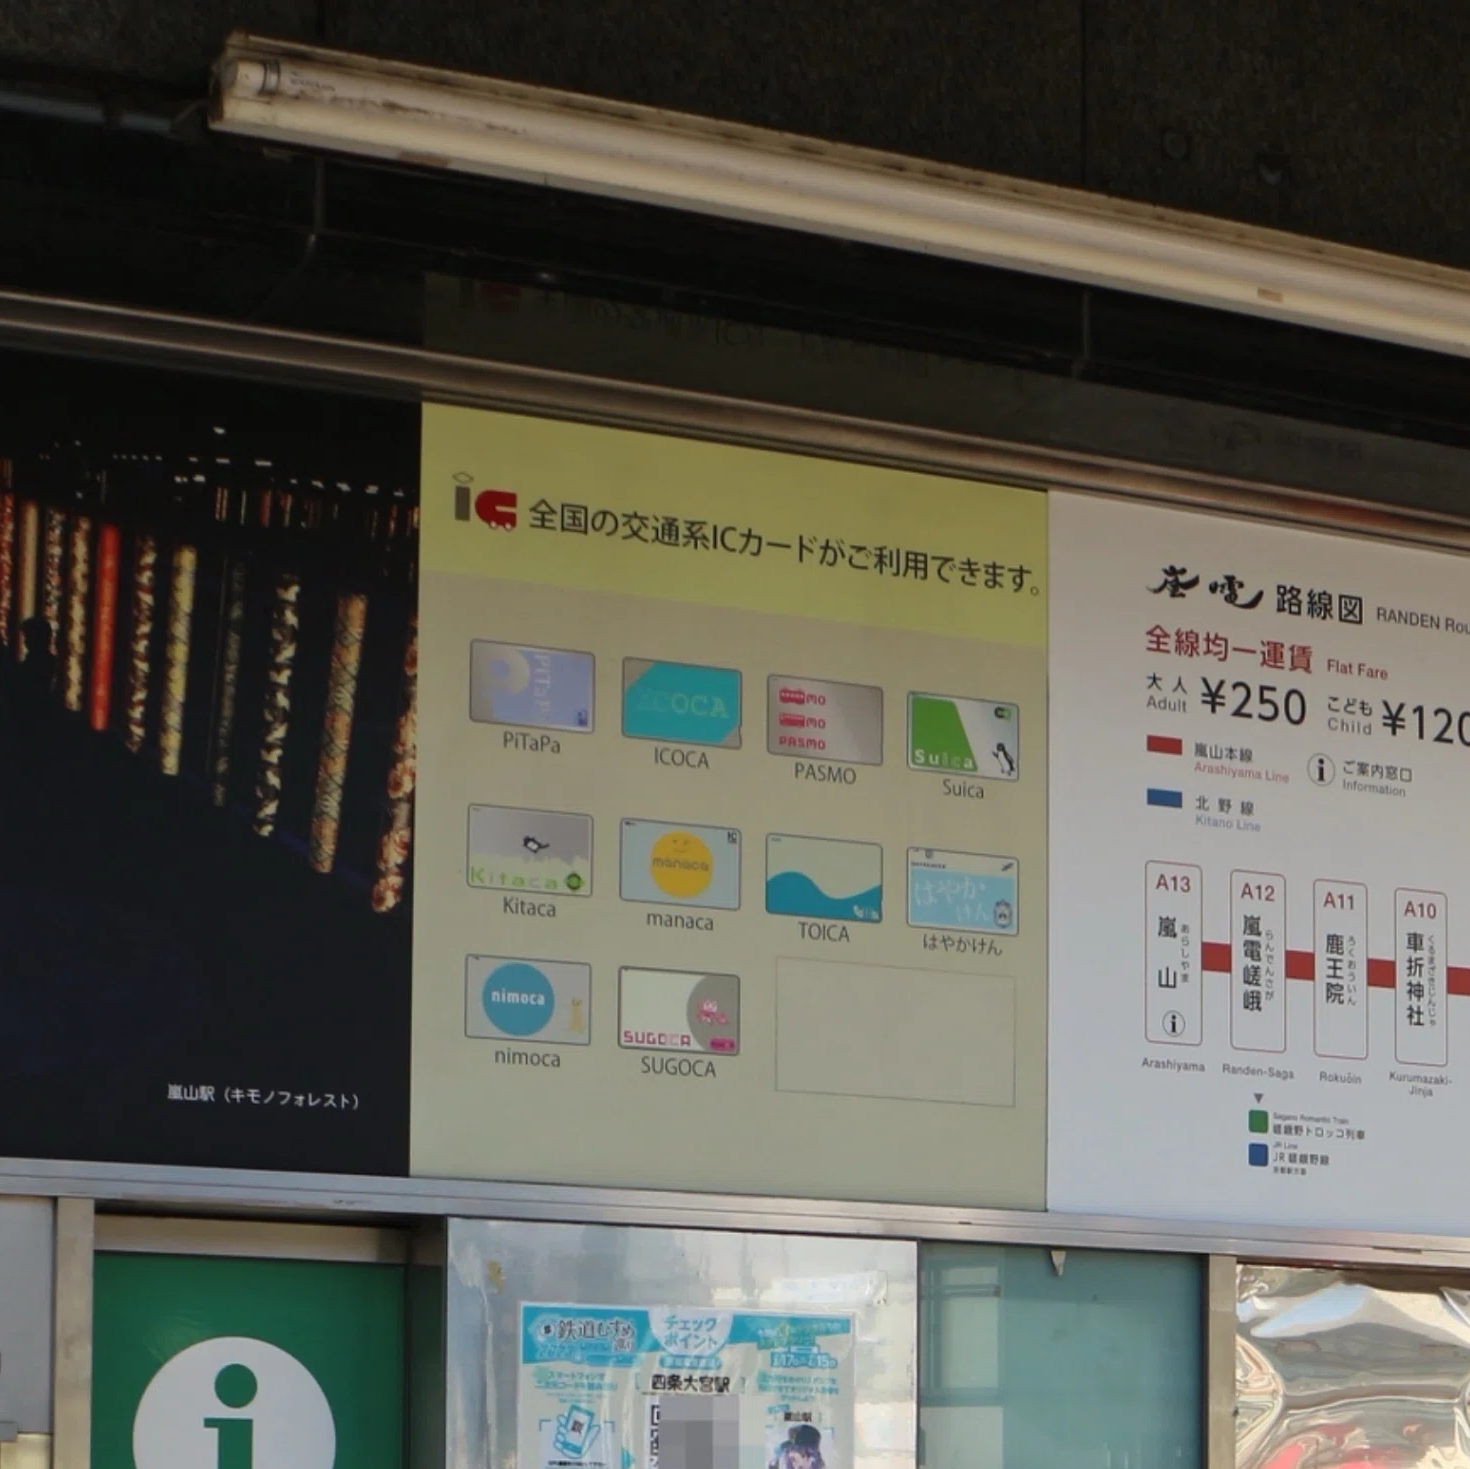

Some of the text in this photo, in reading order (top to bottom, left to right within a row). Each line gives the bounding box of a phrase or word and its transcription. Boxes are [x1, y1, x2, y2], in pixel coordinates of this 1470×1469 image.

[529, 498, 1039, 596] 全国の交通系ICカードがご利用できます。
[1276, 585, 1363, 625] 路線図
[1377, 607, 1440, 630] RANDEN
[1146, 625, 1388, 680] 全線均一運賃 Flat Fare
[1200, 677, 1307, 725] ¥250
[1328, 698, 1373, 717] こども
[1147, 697, 1372, 736] Adult Child
[503, 731, 561, 754] PiTaPa
[779, 735, 826, 750] PASMO
[654, 747, 710, 770] ICOCA
[1195, 743, 1253, 763] 嵐山本線
[795, 762, 856, 785] PASMO
[1195, 762, 1289, 784] Arashiyama Line
[1343, 761, 1412, 782] ご案内窓口
[943, 779, 984, 800] Suica
[1343, 780, 1406, 798] Information
[1195, 816, 1261, 832] Kitano Line
[1156, 874, 1191, 893] A13
[1241, 883, 1275, 902] A12
[503, 896, 556, 917] Kitaca
[1323, 893, 1354, 910] A11
[1404, 901, 1436, 919] A10
[647, 912, 713, 931] manaca
[798, 922, 849, 943] TOICA
[923, 934, 1002, 956] はやかけん
[1158, 916, 1177, 990] 嵐山
[1243, 915, 1262, 1013] 嵐電嵯峨
[1326, 934, 1344, 1005] 鹿王院
[1406, 933, 1425, 1026] 車折神社
[491, 989, 546, 1006] nimoca
[495, 1048, 561, 1068] nimoca
[641, 1056, 716, 1078] SUGOCA
[1142, 1057, 1205, 1073] Arashiyama
[1223, 1063, 1294, 1080] Randen-Saga
[1390, 1072, 1452, 1086] Kurumazaki-
[167, 1084, 215, 1102] 嵐山駅
[1409, 1085, 1433, 1097] Jinja
[664, 1315, 717, 1331] チェック
[664, 1333, 718, 1349] ポイント
[652, 1374, 730, 1393] 四条大宮駅
